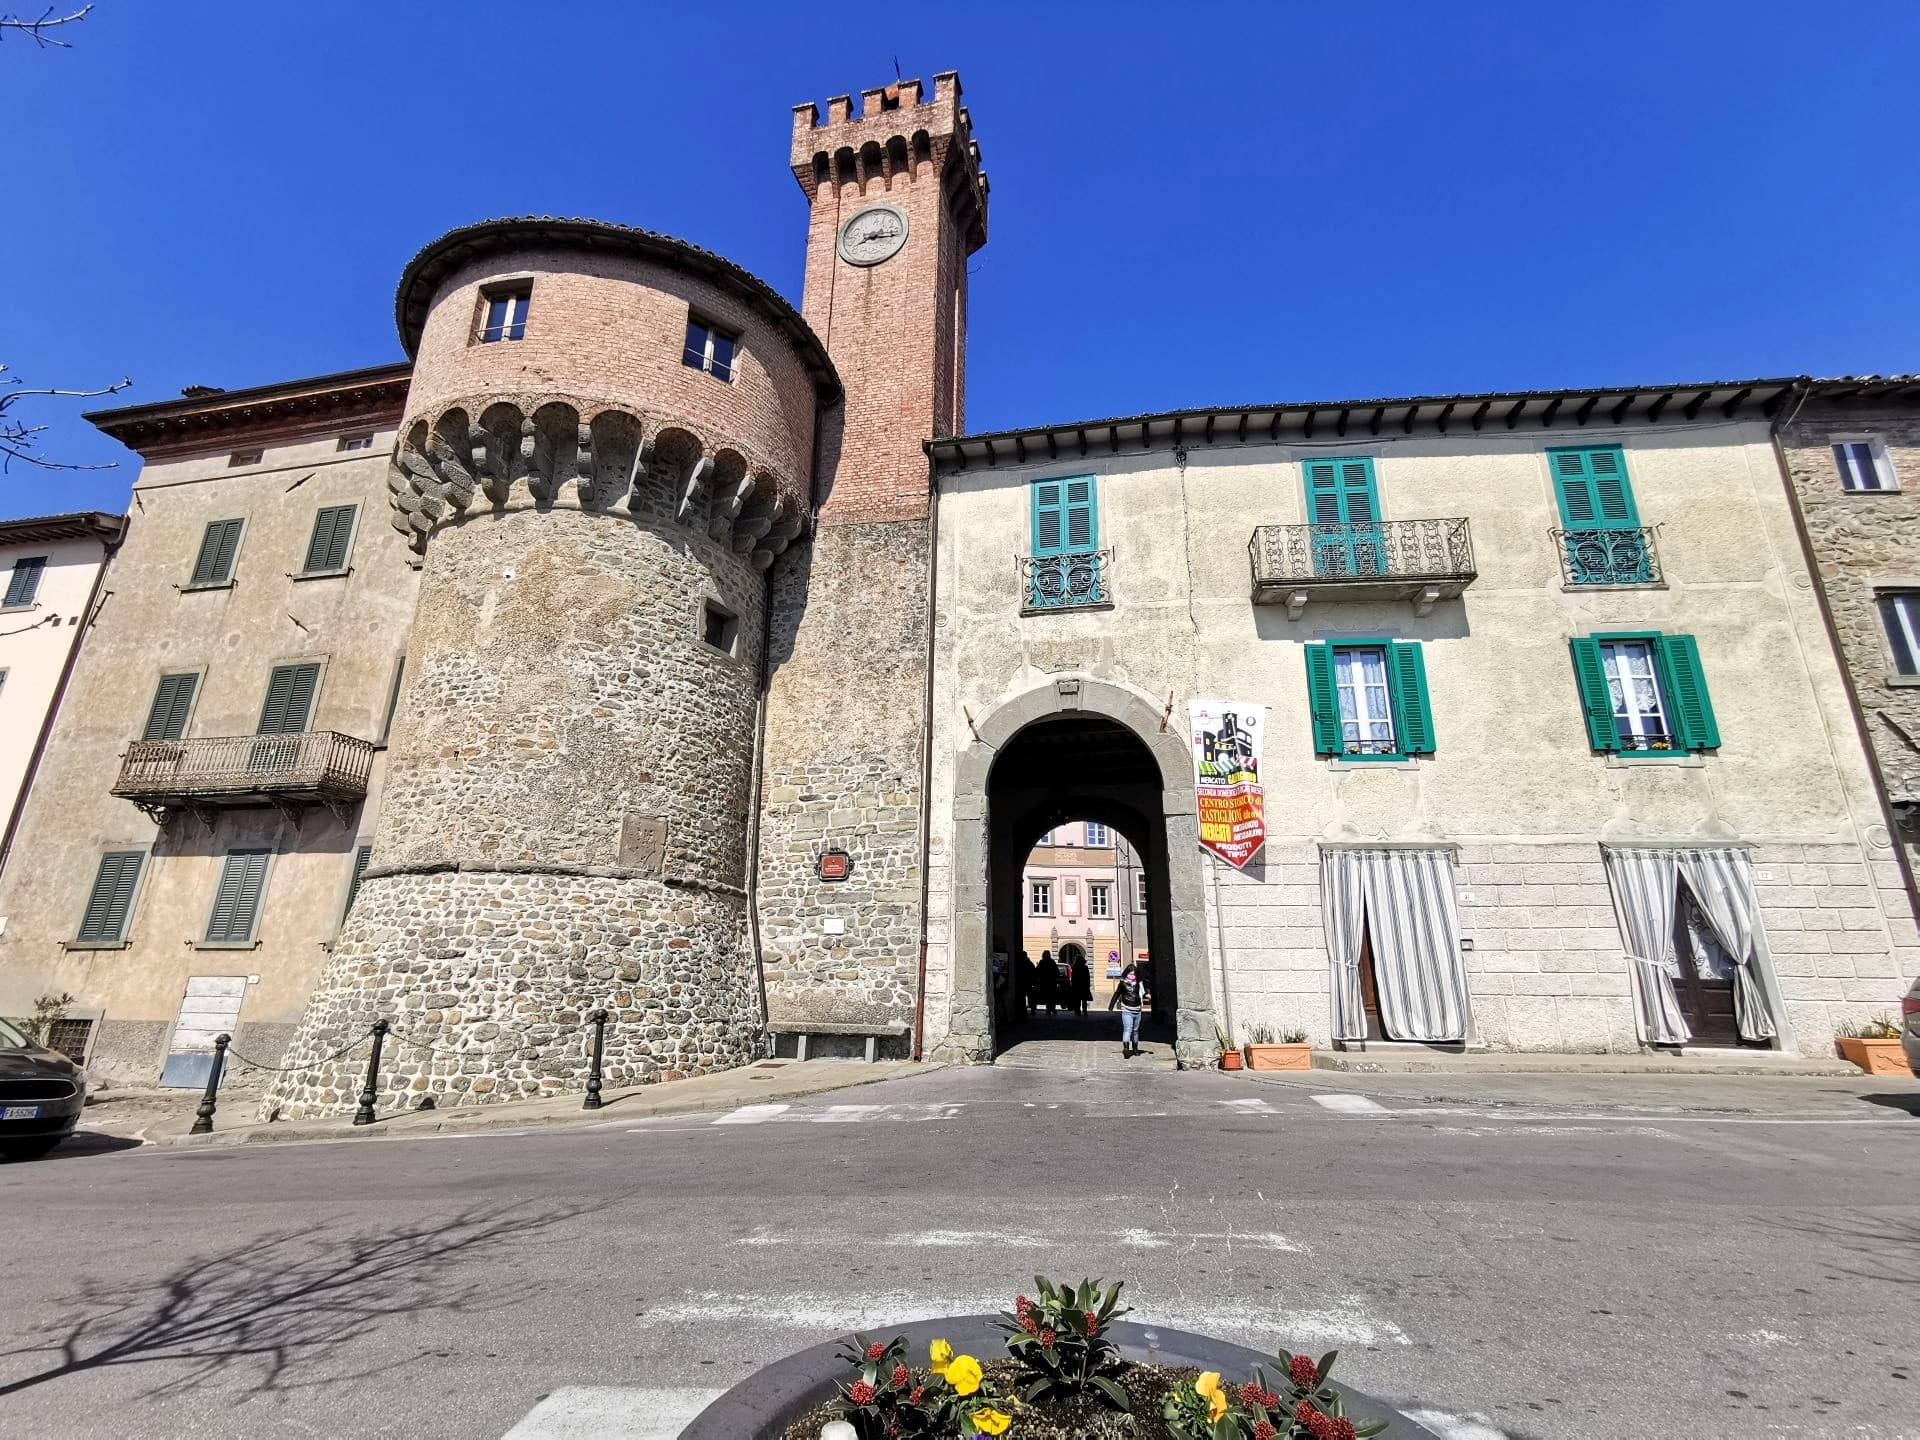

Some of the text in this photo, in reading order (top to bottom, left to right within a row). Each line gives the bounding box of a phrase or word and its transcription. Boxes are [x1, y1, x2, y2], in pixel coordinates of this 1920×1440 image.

[1200, 776, 1226, 785] MERCATO
[1200, 797, 1228, 808] CENTRO
[1229, 794, 1254, 808] STORICO
[1201, 822, 1231, 843] MERCATO
[1216, 841, 1252, 851] PRODOTTI
[1226, 850, 1247, 858] TIPICI
